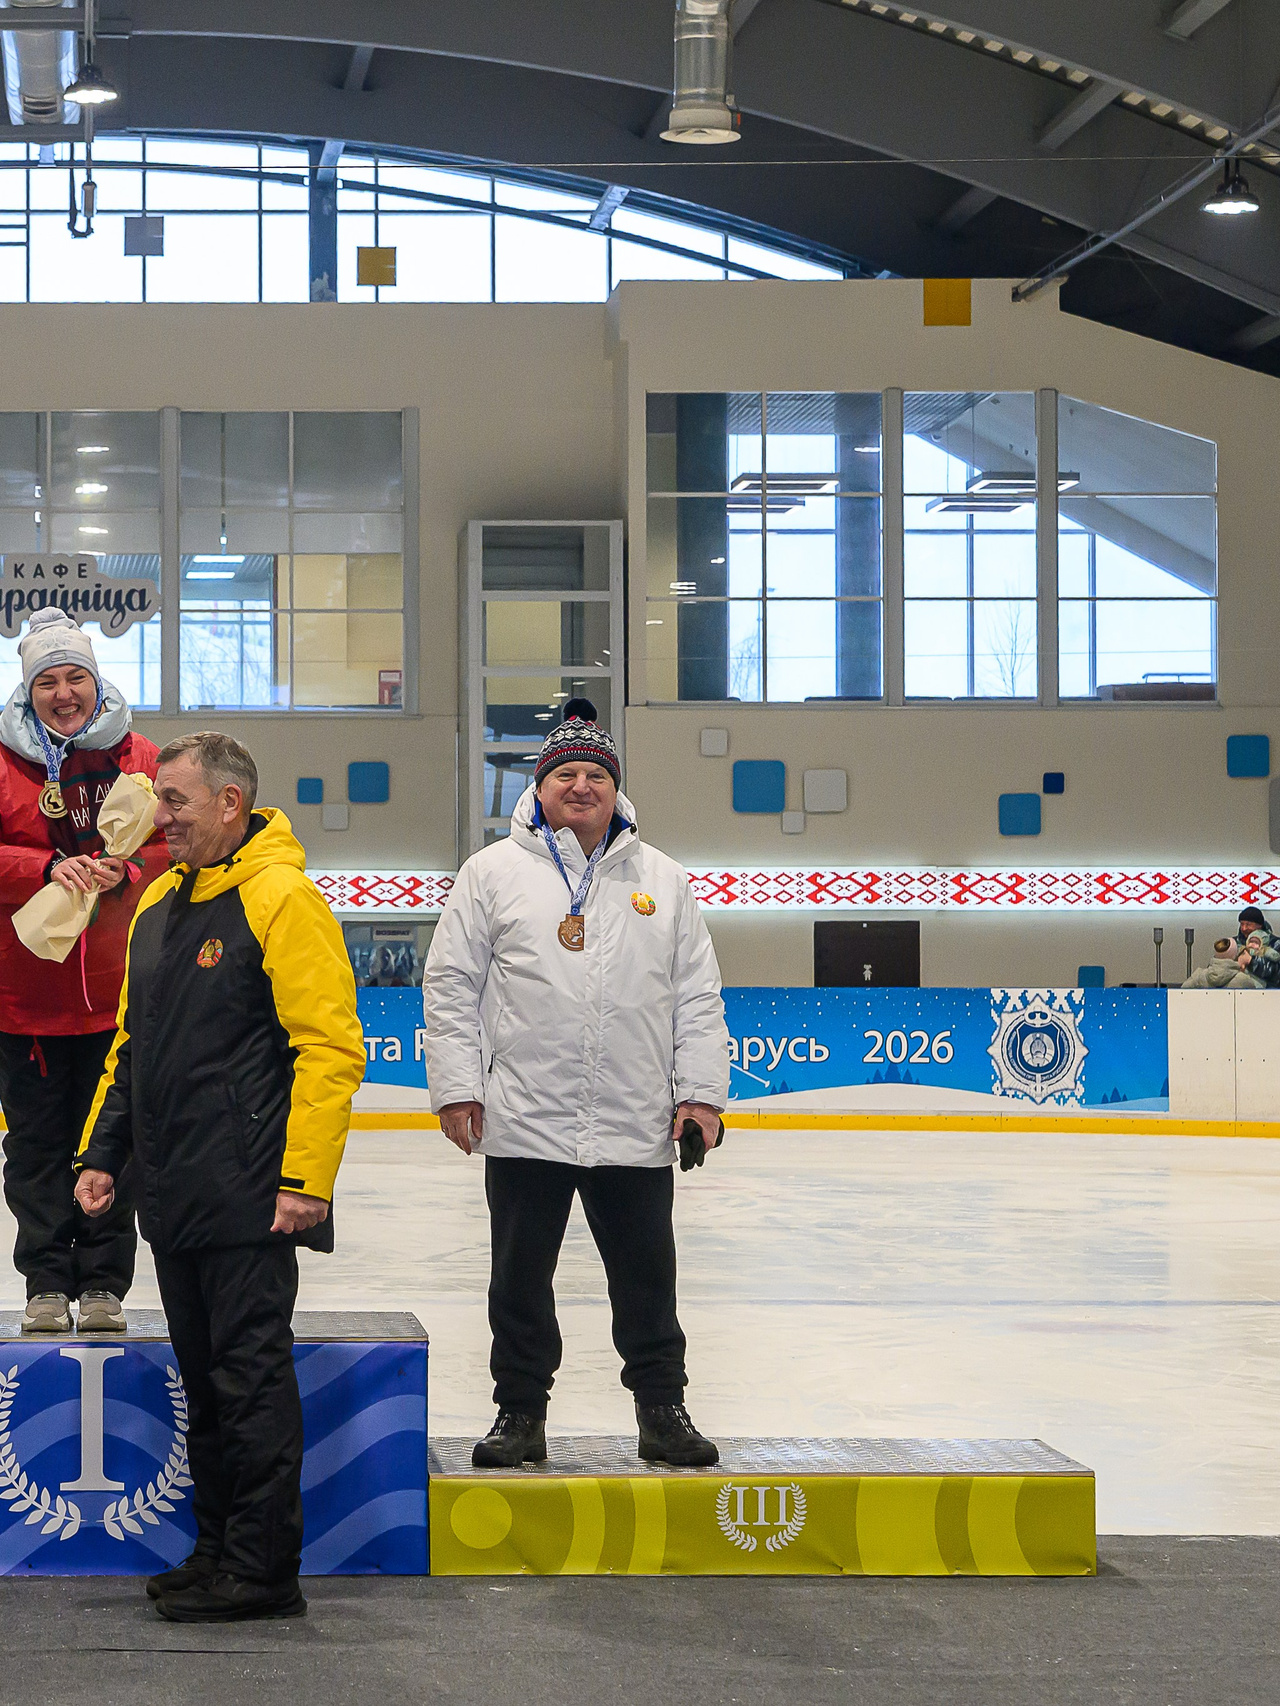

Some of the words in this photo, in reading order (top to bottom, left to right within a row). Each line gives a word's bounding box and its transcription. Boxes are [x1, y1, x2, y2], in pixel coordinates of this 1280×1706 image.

[13, 563, 88, 579] КАФЕ
[726, 1036, 830, 1072] арусь
[862, 1030, 954, 1064] 2026
[731, 1486, 792, 1526] III
